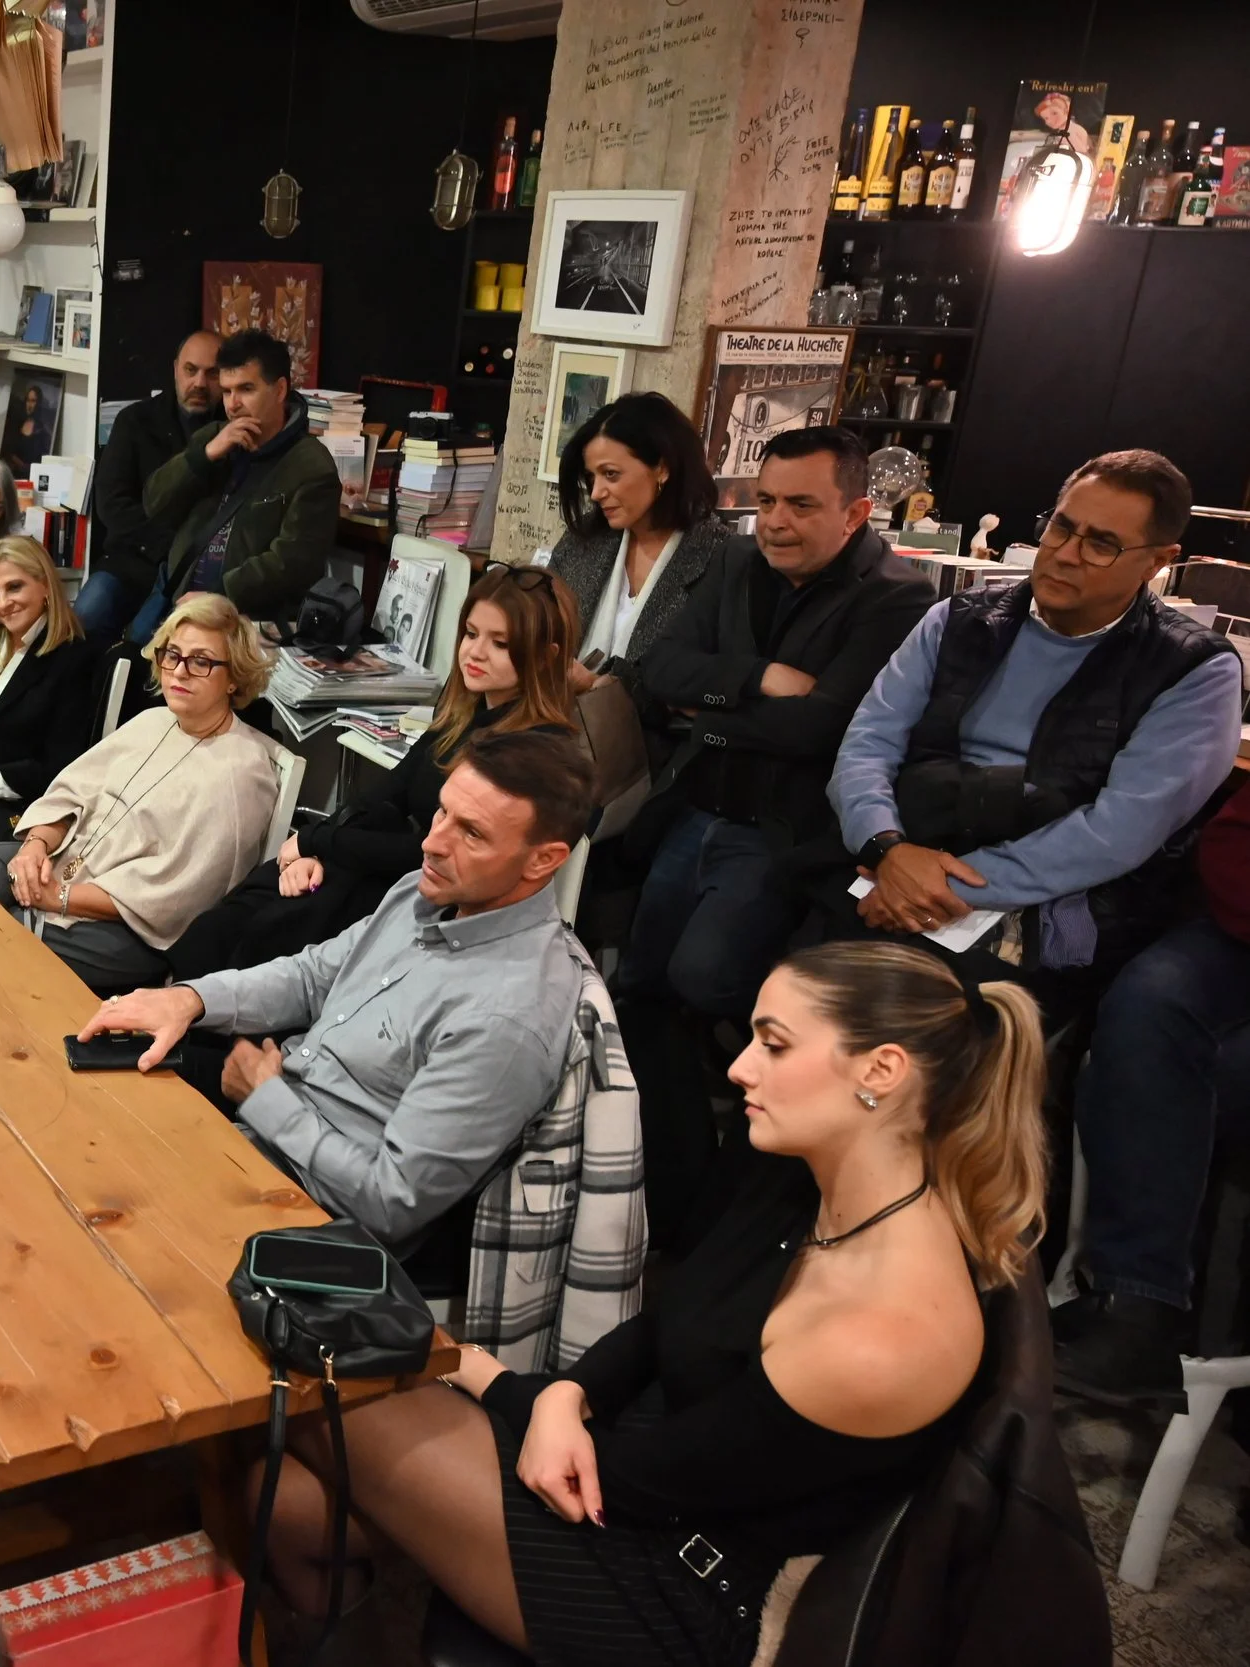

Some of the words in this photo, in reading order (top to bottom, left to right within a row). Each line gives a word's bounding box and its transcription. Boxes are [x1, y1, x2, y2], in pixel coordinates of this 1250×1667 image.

[736, 223, 765, 233] ΚΟΜΜΑ
[727, 334, 765, 351] THEATRE
[767, 338, 782, 351] DE
[783, 339, 794, 351] LA
[797, 336, 844, 352] HUCHETTE
[811, 411, 823, 421] 50
